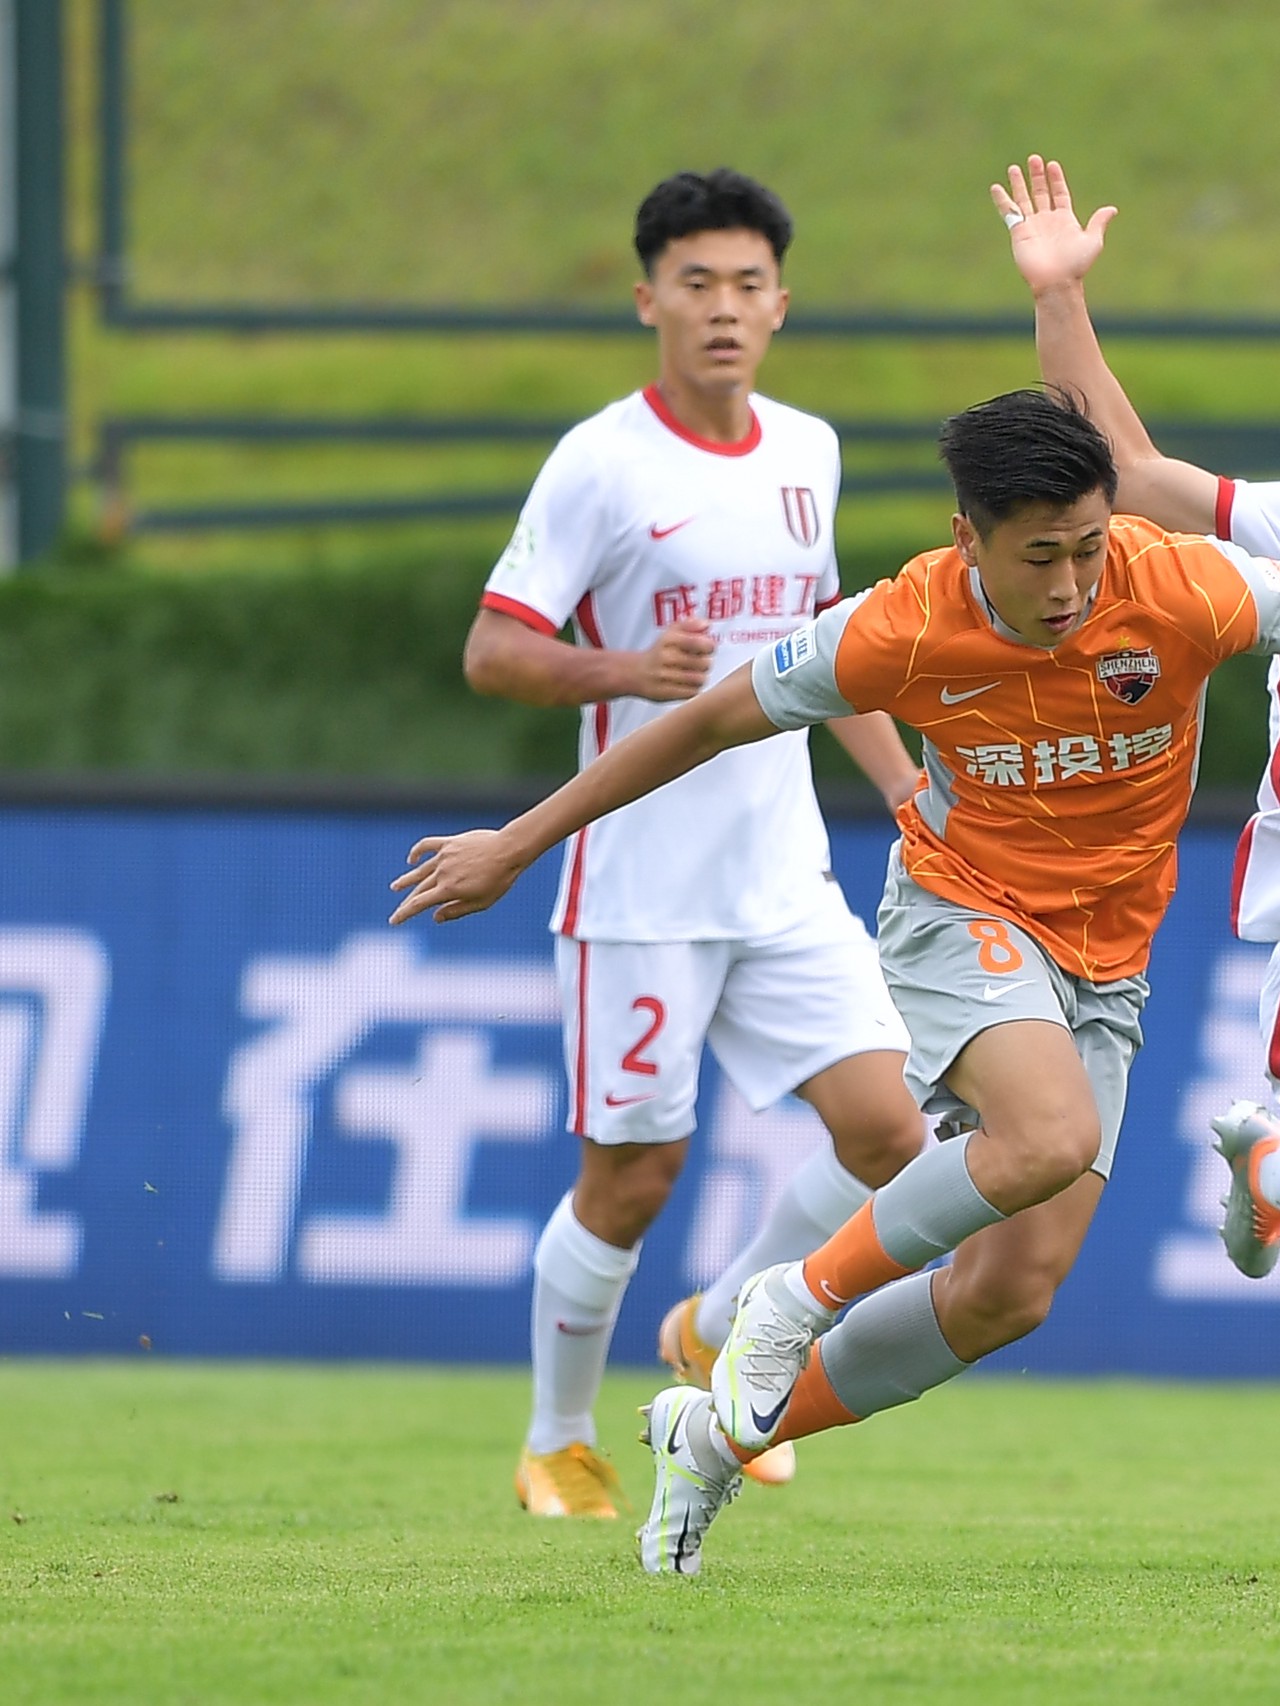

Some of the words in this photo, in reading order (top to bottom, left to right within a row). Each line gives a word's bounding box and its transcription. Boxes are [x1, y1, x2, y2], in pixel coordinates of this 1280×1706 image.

[654, 574, 821, 627] 成都建工
[1100, 658, 1155, 672] SHENZHEN
[955, 723, 1173, 787] 深投控
[966, 920, 1024, 975] 8
[621, 996, 668, 1076] 2
